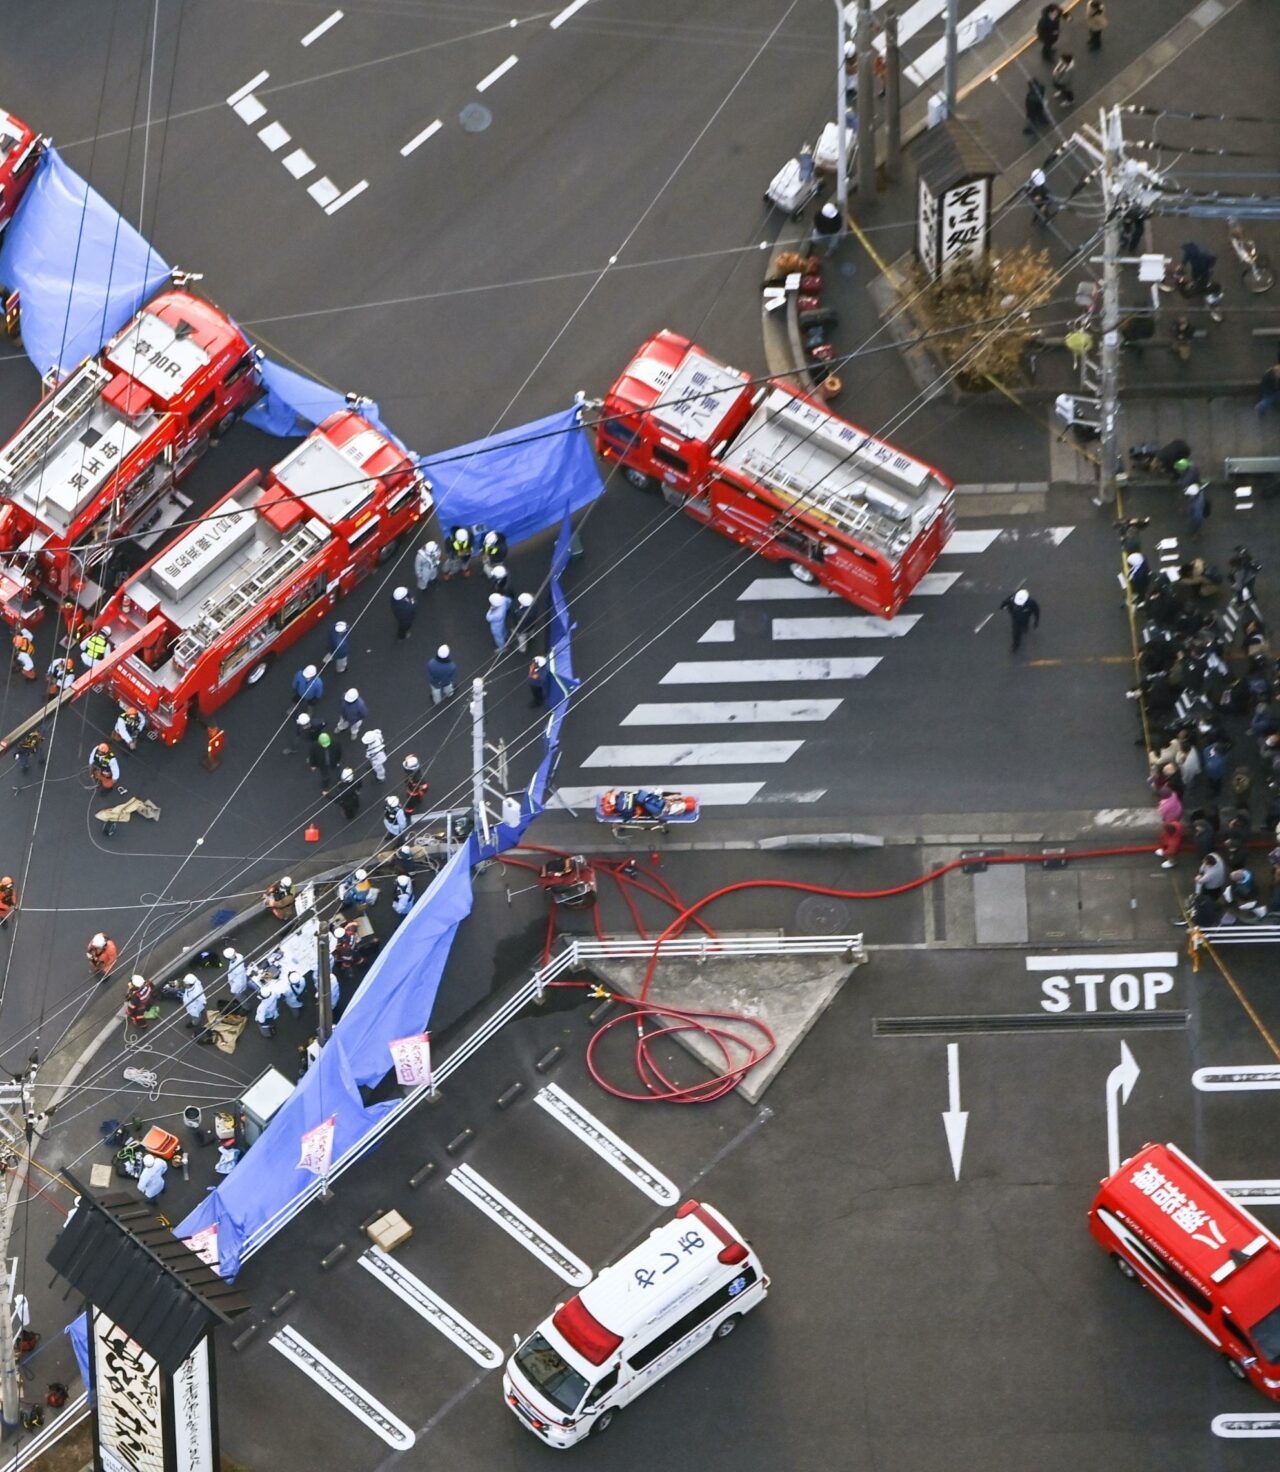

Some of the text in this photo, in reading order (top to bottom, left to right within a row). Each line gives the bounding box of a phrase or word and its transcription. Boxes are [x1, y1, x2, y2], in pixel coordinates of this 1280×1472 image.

[131, 339, 183, 379] 草加R
[67, 441, 120, 492] 埼玉県
[1040, 971, 1174, 1013] STOP
[1129, 1162, 1227, 1250] 八潮指揮
[634, 1230, 705, 1289] やしお
